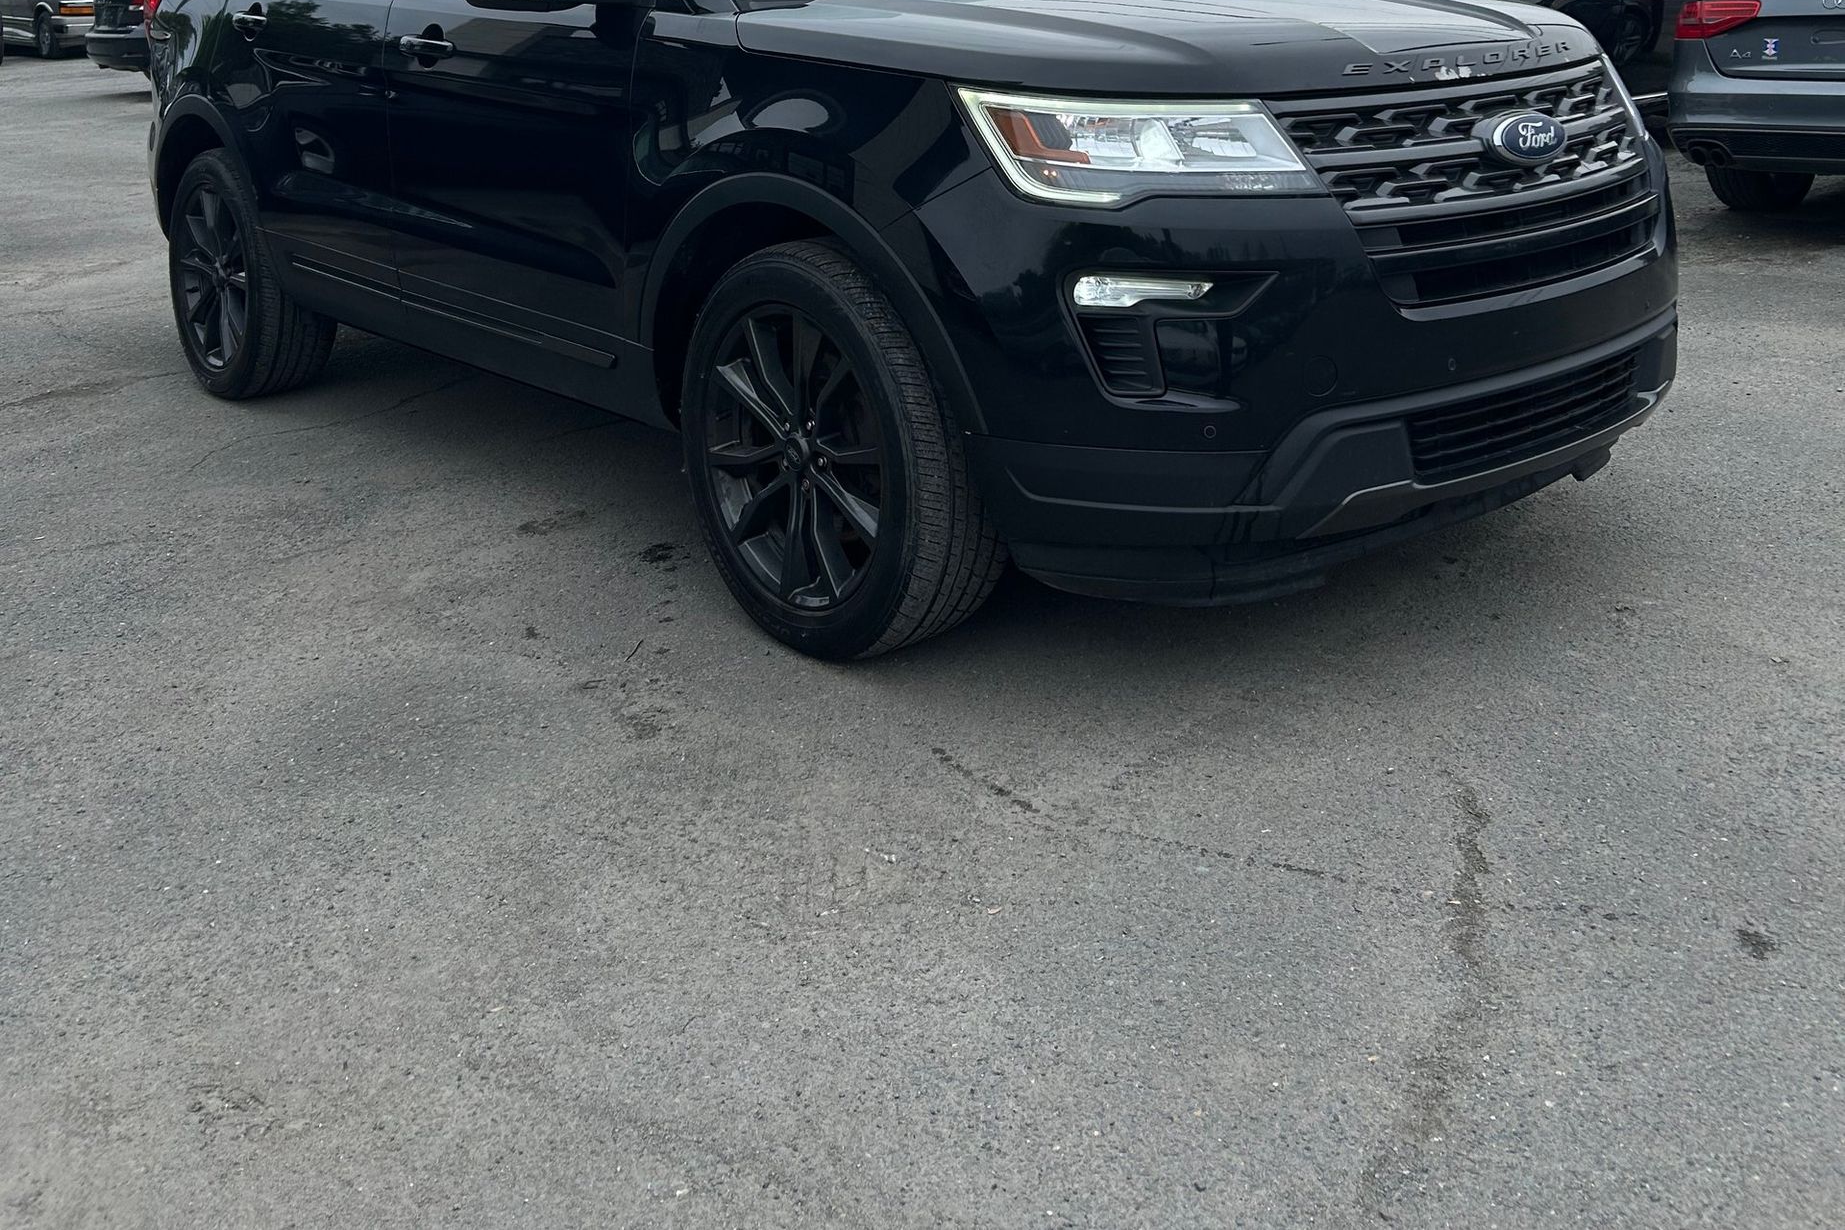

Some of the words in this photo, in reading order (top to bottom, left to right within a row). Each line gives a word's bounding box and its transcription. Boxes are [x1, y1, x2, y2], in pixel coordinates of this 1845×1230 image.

[1341, 40, 1571, 76] EXPLORER
[1729, 48, 1753, 59] A4
[1517, 121, 1557, 150] Ford
